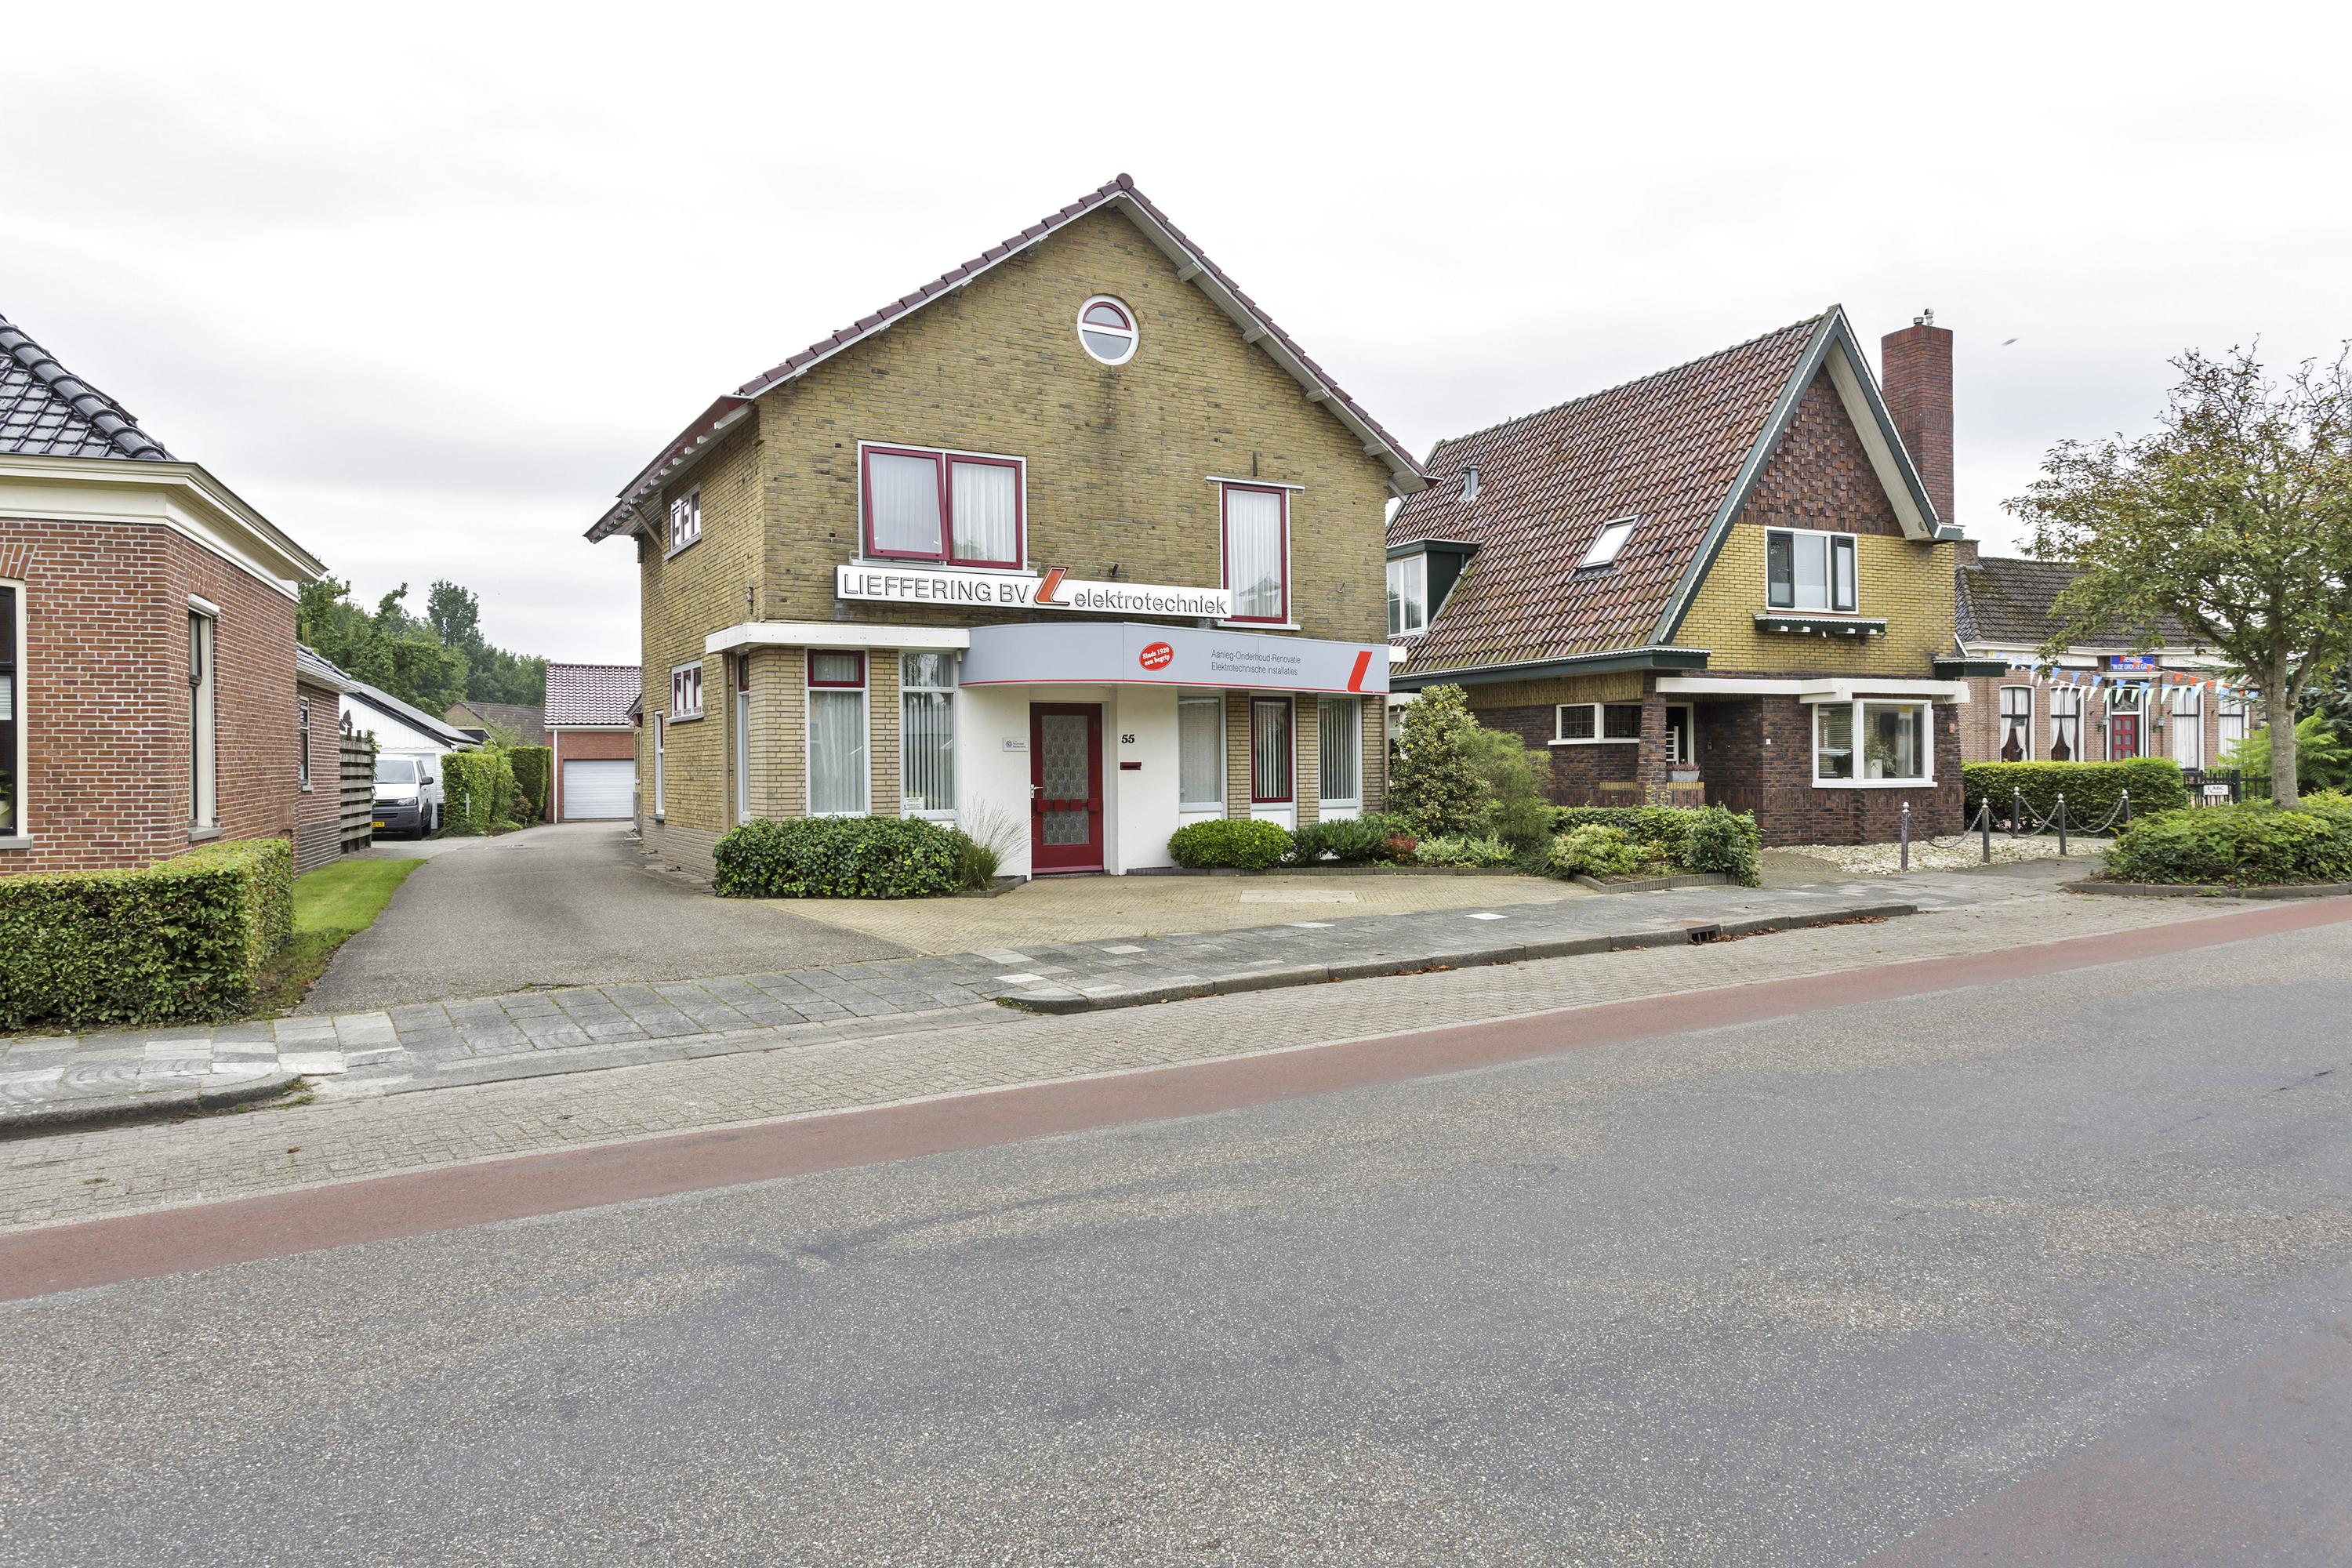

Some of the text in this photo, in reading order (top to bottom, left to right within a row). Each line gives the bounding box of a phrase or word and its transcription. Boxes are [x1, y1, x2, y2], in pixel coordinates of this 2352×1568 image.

[844, 573, 1030, 604] LIEFFERING BV
[1074, 588, 1228, 615] elektrotechniek
[1142, 647, 1170, 659] Sinds 1920
[1154, 654, 1170, 662] begrip
[1211, 662, 1266, 674] Elektrotechnische
[1121, 734, 1135, 744] 55
